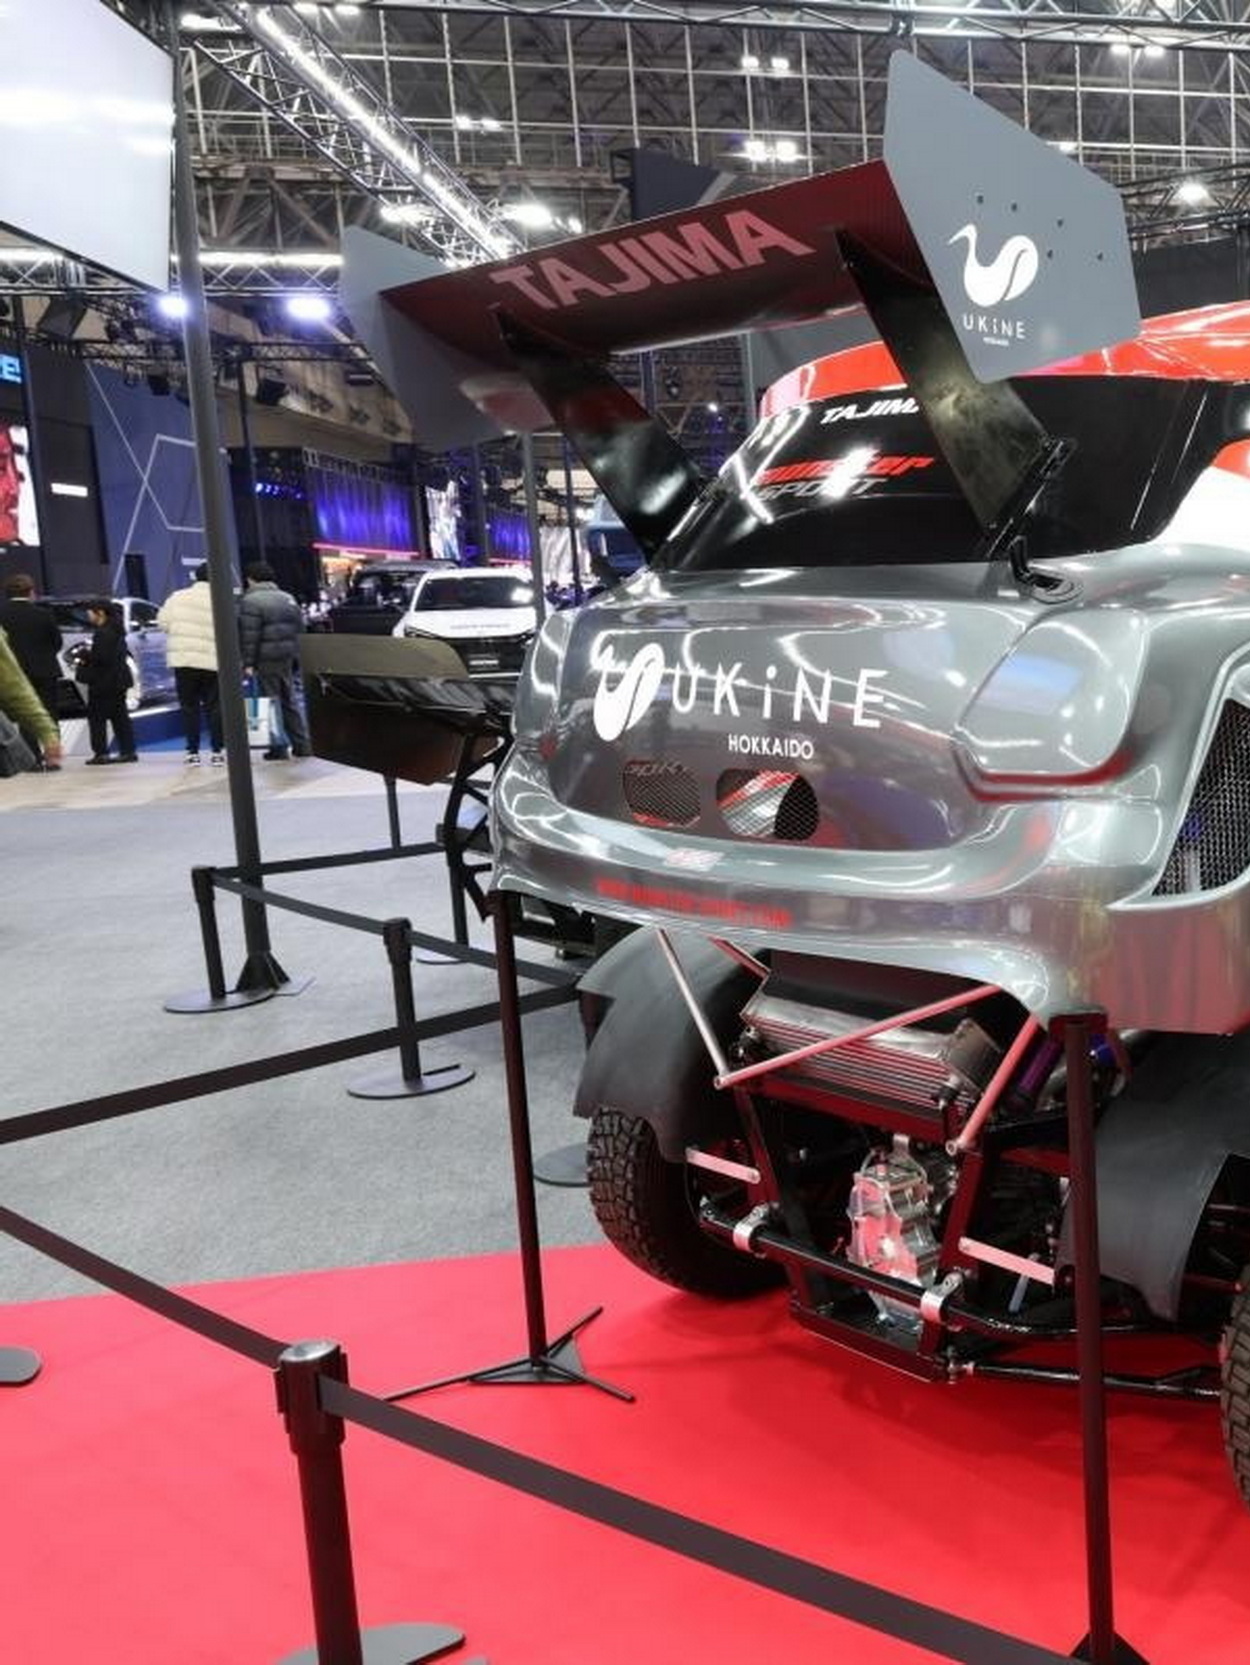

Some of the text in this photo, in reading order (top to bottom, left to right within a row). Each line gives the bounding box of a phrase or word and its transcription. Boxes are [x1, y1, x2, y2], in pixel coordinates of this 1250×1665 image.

[489, 210, 817, 310] TAJIMA
[820, 398, 919, 424] TAJIM
[728, 733, 815, 760] HOKKAIDO
